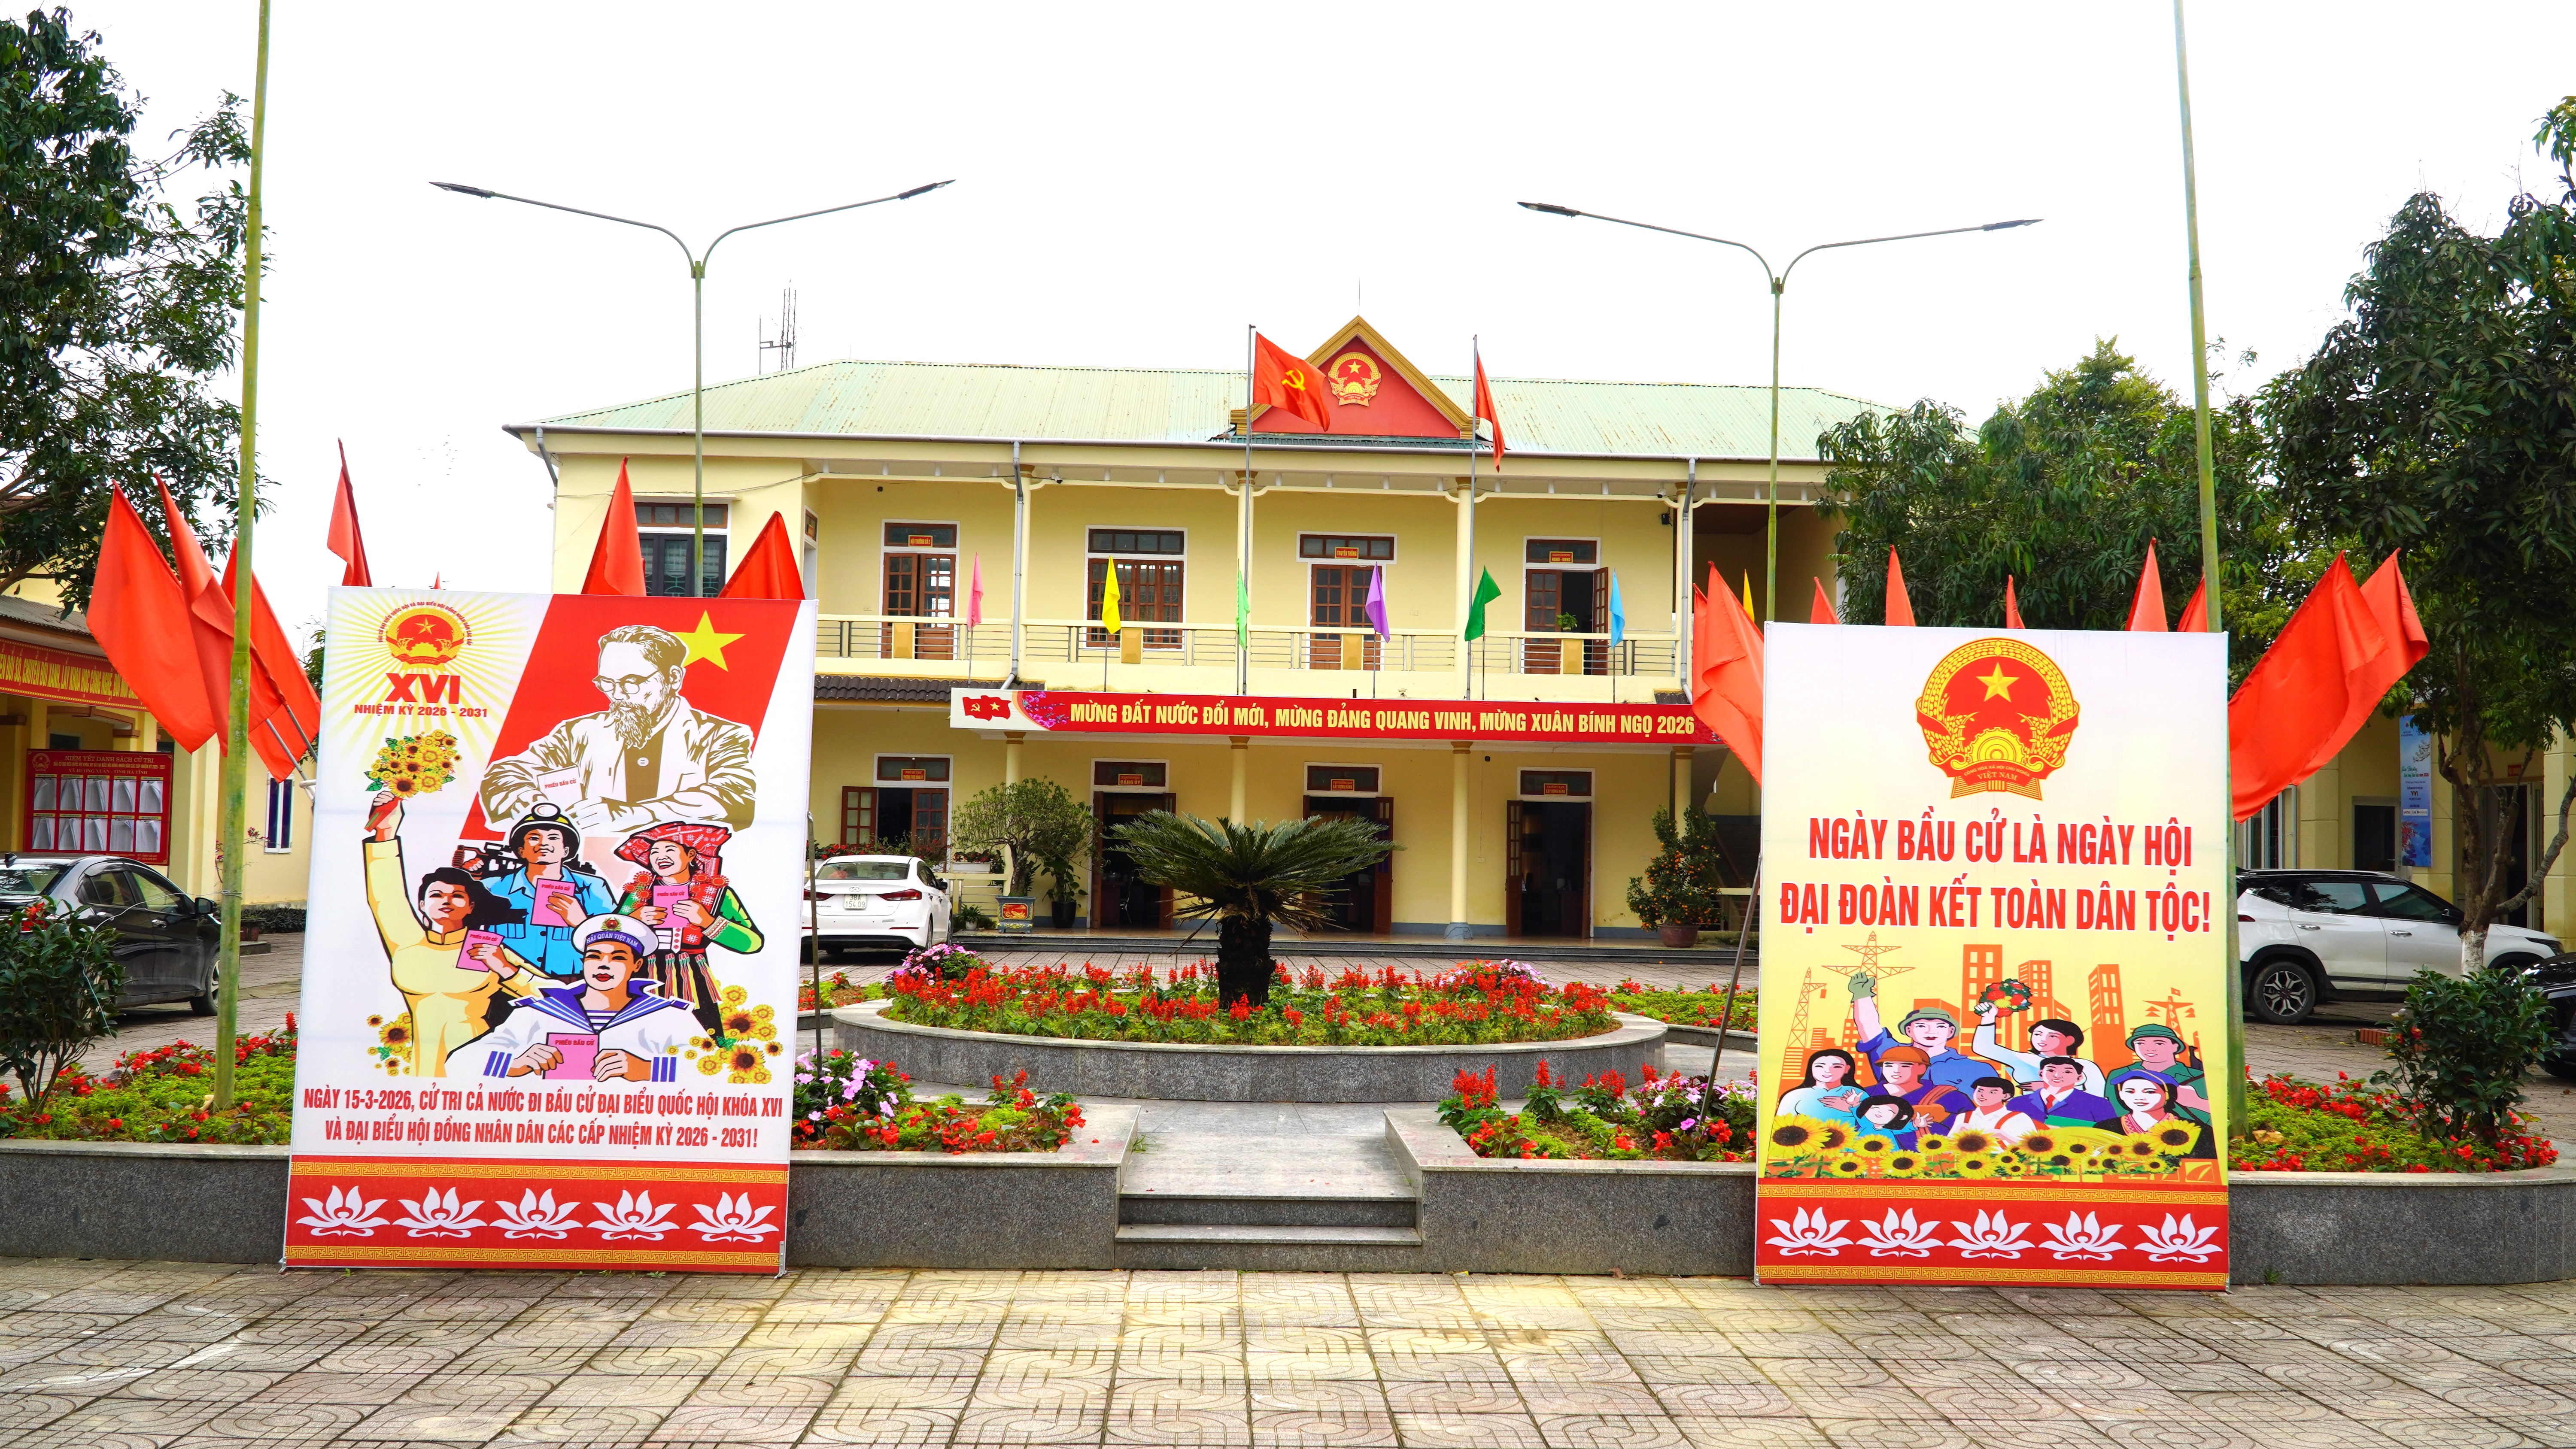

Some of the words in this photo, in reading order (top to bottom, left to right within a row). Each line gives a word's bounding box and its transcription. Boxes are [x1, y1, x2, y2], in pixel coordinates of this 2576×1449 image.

[384, 673, 461, 704] XVI
[355, 703, 395, 716] NHIỆM
[399, 704, 414, 715] KỲ
[417, 706, 447, 716] 2026
[459, 708, 487, 717] 2031
[1070, 699, 1117, 723] MỪNG
[1121, 699, 1151, 723] ĐẤT
[1156, 700, 1198, 724] NƯỚC
[1202, 700, 1229, 725] ĐỔI
[1234, 703, 1269, 728] MỚI,
[1275, 704, 1322, 728] MỪNG
[1327, 702, 1370, 728] ĐẢNG
[1375, 710, 1429, 731] QUANG
[1434, 712, 1476, 733] VINH,
[1480, 709, 1526, 731] MỪNG
[1531, 710, 1574, 732] XUÂN
[1578, 710, 1616, 733] BÍNH
[1620, 715, 1653, 737] NGỌ
[1657, 715, 1694, 734] 2026
[1977, 770, 1997, 779] VIỆT
[1999, 772, 2017, 781] NAM
[1809, 809, 1888, 860] NGÀY
[1897, 806, 1955, 862] BẦU
[1965, 807, 2007, 864] CỬ
[2013, 814, 2047, 864] LÀ
[2057, 815, 2135, 865] NGÀY
[2145, 817, 2192, 876] HỘI
[1780, 882, 1829, 934] ĐẠI
[1838, 876, 1919, 926] ĐOÀN
[1929, 873, 1982, 928] KẾT
[1990, 879, 2066, 929] TOÀN
[2076, 880, 2136, 931] DÂN
[2145, 880, 2210, 941] TỘC!
[586, 934, 596, 943] HẢI
[597, 931, 613, 940] QUÂN
[626, 937, 638, 947] NAM
[304, 1085, 340, 1109] NGÀY
[344, 1090, 414, 1111] 15-3-2026,
[419, 1082, 440, 1110] CỬ
[441, 1091, 462, 1111] TRI
[466, 1083, 483, 1111] CẢ
[487, 1087, 524, 1112] NƯỚC
[528, 1092, 542, 1112] ĐI
[545, 1086, 572, 1113] BẦU
[576, 1085, 596, 1113] CỬ
[597, 1094, 620, 1118] ĐẠI
[623, 1086, 654, 1115] BIỂU
[657, 1089, 693, 1117] QUỐC
[696, 1092, 719, 1120] HỘI
[722, 1093, 757, 1117] KHÓA
[761, 1097, 783, 1117] XVI
[325, 1116, 342, 1140] VÀ
[345, 1121, 369, 1145] ĐẠI
[372, 1114, 403, 1141] BIỂU
[407, 1118, 430, 1146] HỘI
[434, 1116, 471, 1142] ĐỒNG
[474, 1119, 512, 1143] NHÂN
[516, 1119, 544, 1143] DÂN
[547, 1118, 574, 1144] CÁC
[578, 1118, 605, 1144] CẤP
[608, 1122, 652, 1149] NHIỆM
[656, 1122, 673, 1146] KỲ
[676, 1127, 708, 1147] 2026
[721, 1128, 758, 1148] 2031!
